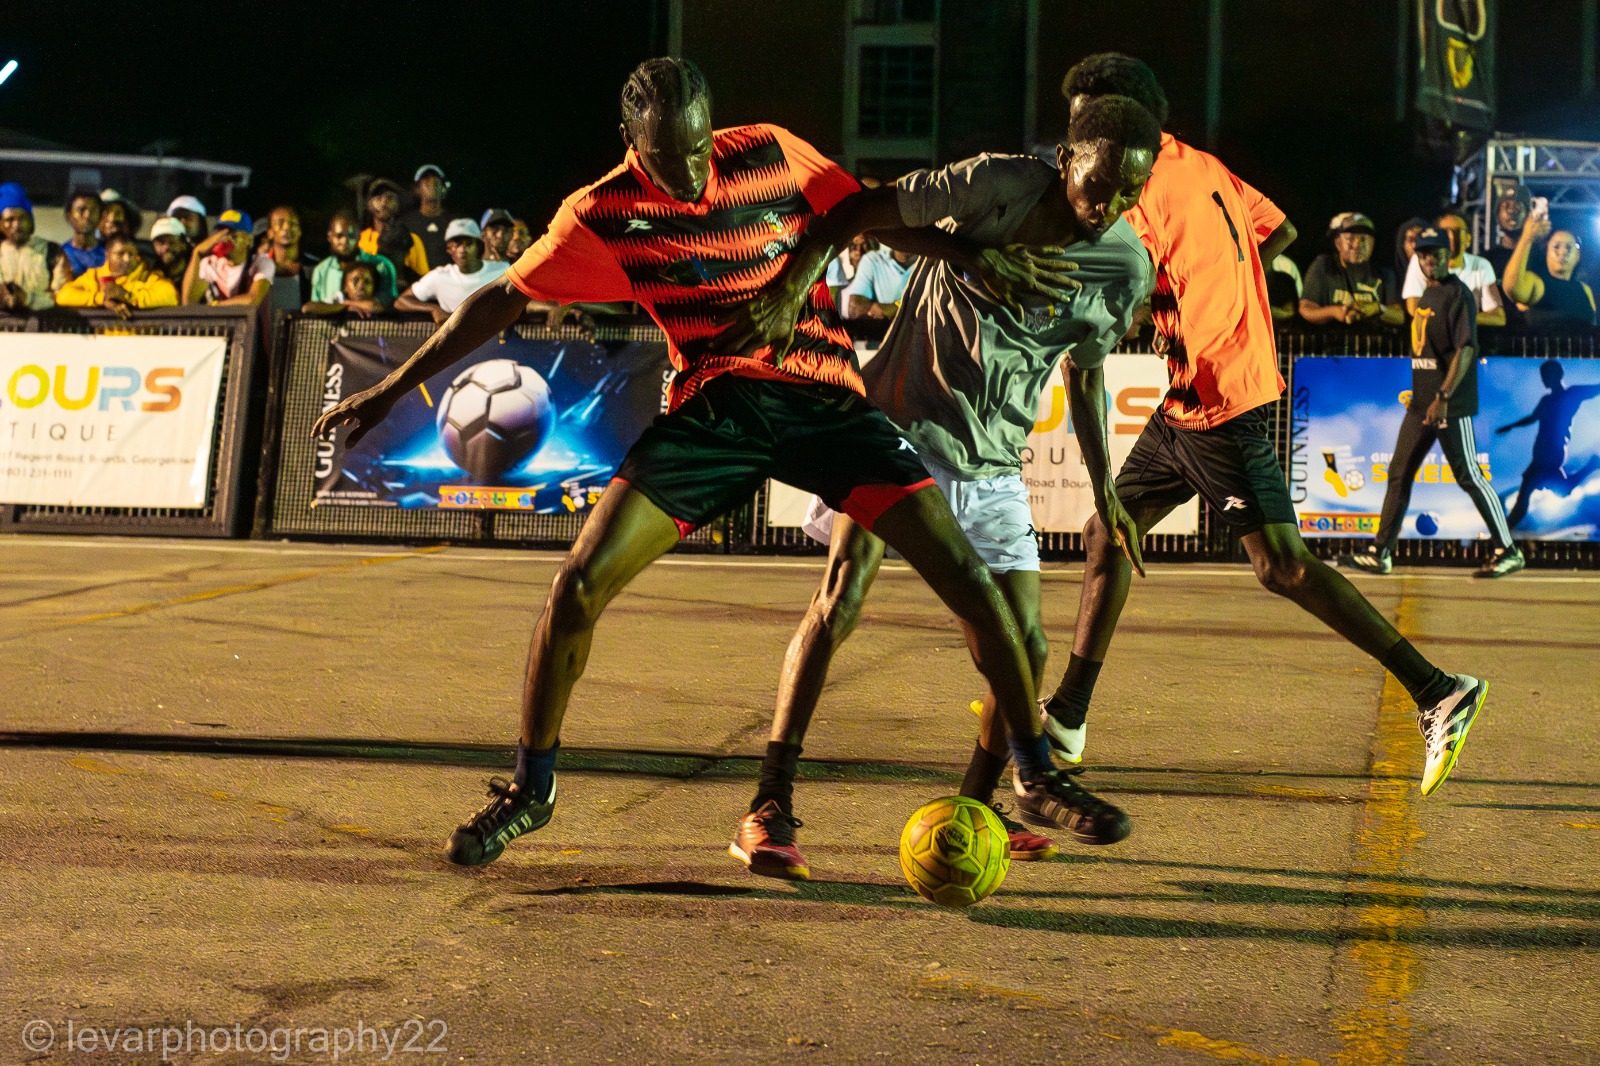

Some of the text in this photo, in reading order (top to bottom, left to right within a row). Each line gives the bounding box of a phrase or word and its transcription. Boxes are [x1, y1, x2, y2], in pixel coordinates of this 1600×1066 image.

[0, 364, 185, 413] OURS
[9, 421, 120, 442] TIQUE
[1289, 386, 1310, 504] GUINNESS
